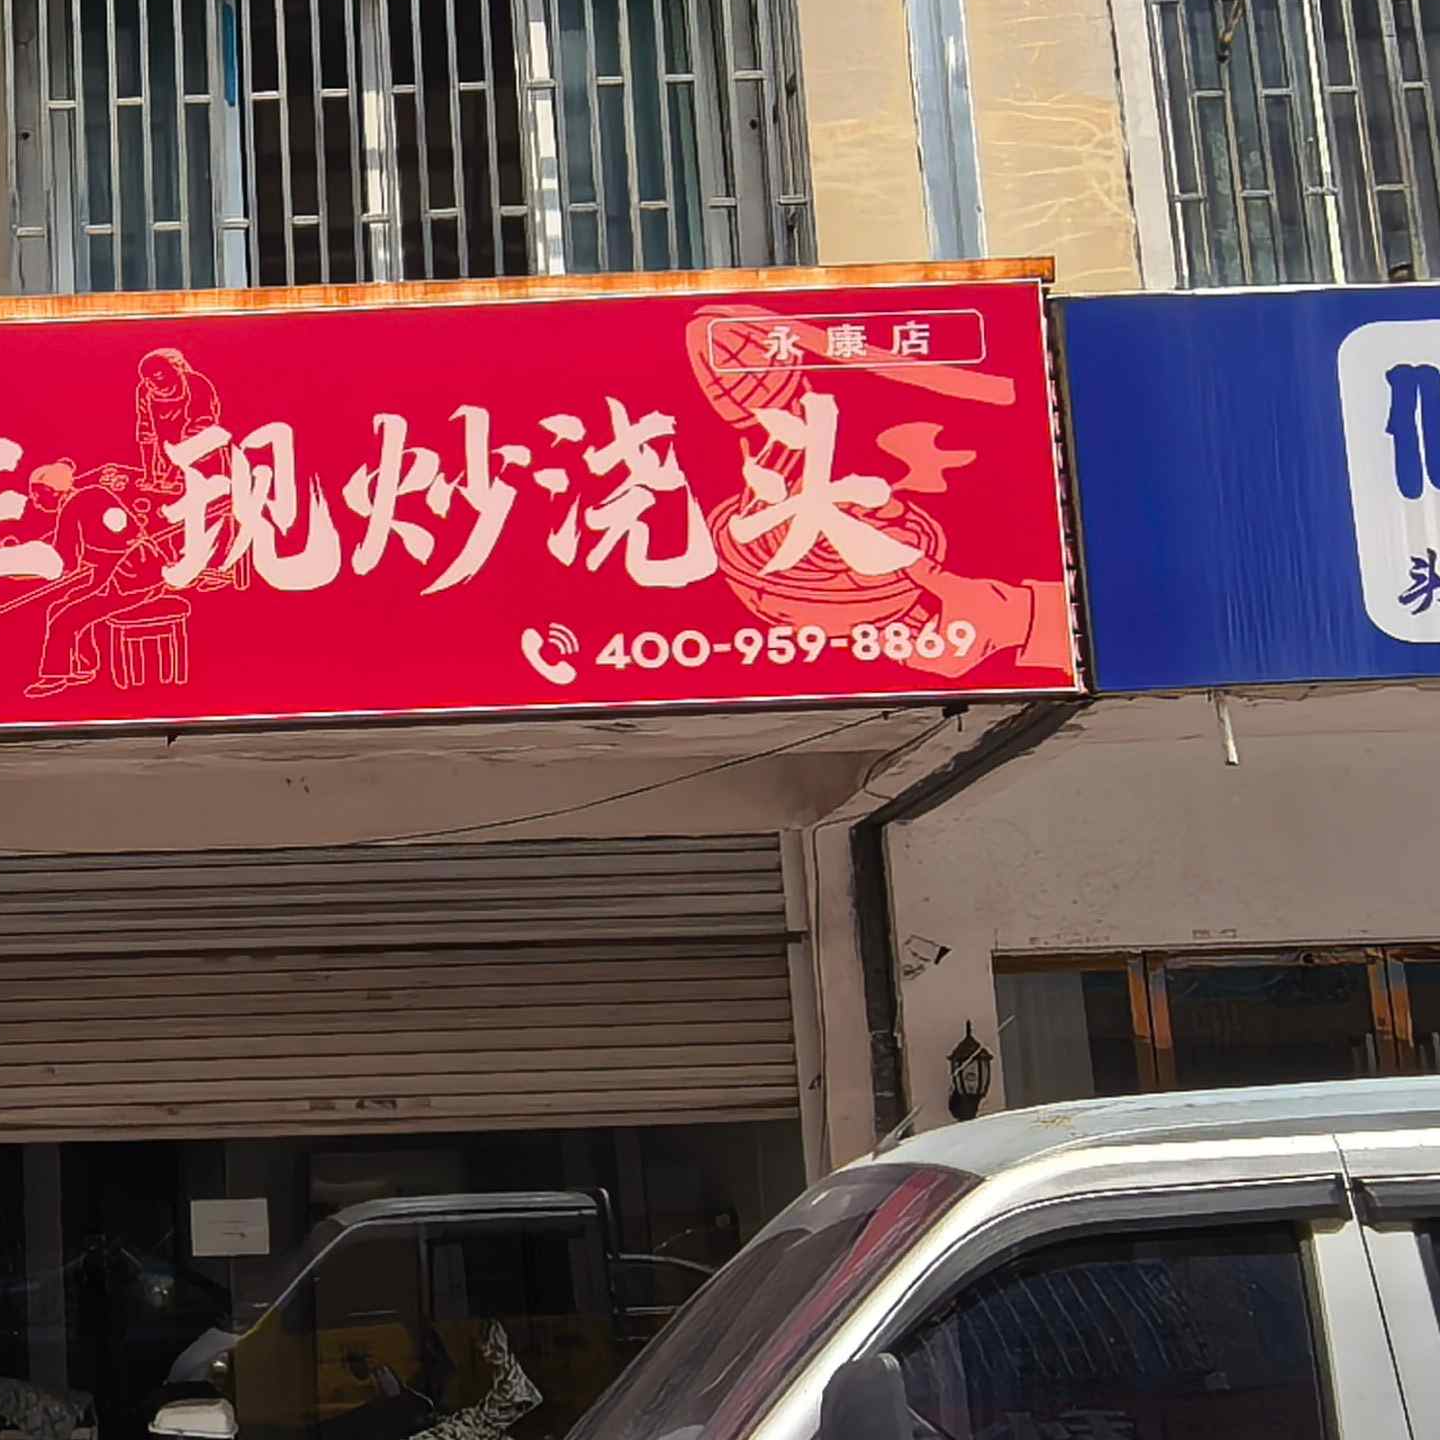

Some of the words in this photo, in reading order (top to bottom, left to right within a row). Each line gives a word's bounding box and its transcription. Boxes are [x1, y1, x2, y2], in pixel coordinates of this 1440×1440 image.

[762, 318, 932, 361] 永康店
[596, 620, 977, 669] 400-959-8869
